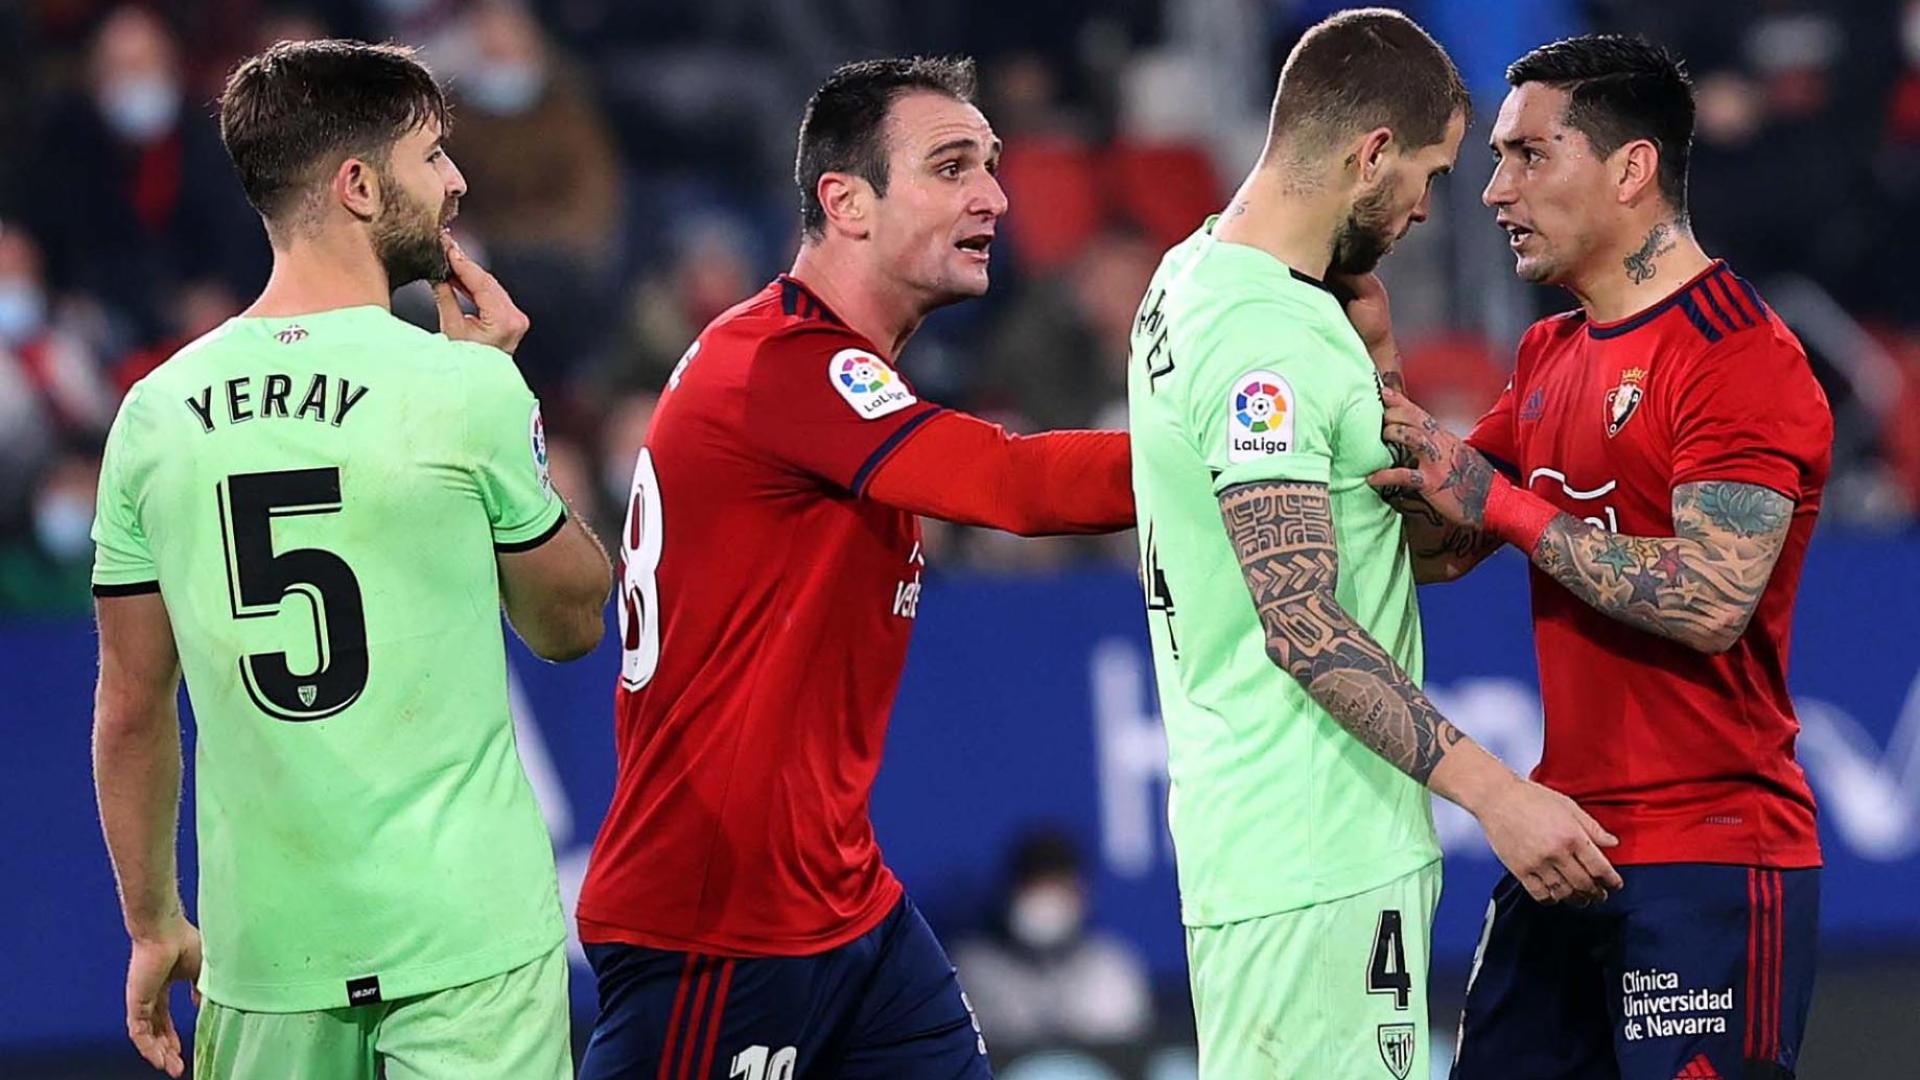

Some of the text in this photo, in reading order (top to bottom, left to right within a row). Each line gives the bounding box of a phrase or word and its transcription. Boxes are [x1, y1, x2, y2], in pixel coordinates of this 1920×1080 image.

[185, 373, 370, 434] YERAY
[1234, 437, 1287, 455] LaLiga
[216, 466, 370, 722] 5
[1366, 909, 1412, 1010] 4
[1622, 968, 1679, 994] Clínica
[1623, 988, 1733, 1018] Universidad
[1624, 1014, 1726, 1040] de Navarra
